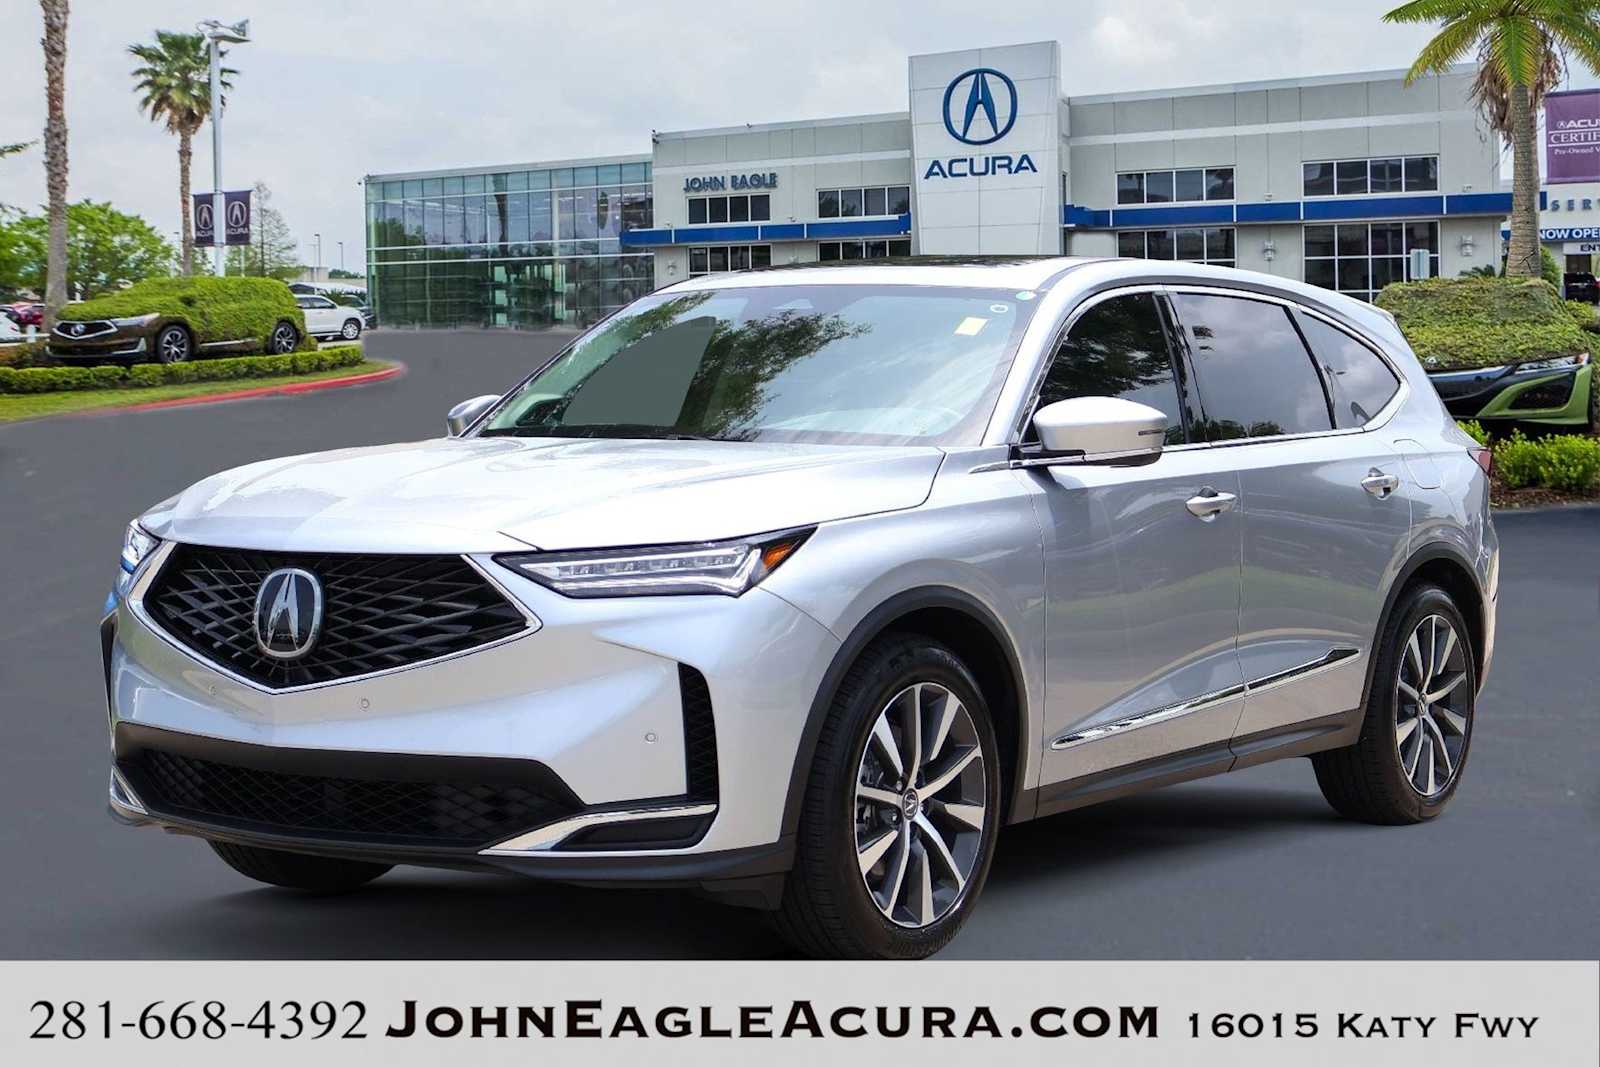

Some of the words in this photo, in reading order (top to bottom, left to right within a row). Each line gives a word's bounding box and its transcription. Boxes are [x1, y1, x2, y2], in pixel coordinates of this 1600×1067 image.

[924, 154, 1038, 179] ACURA
[683, 176, 725, 192] JOHN
[731, 173, 777, 190] EAGLE
